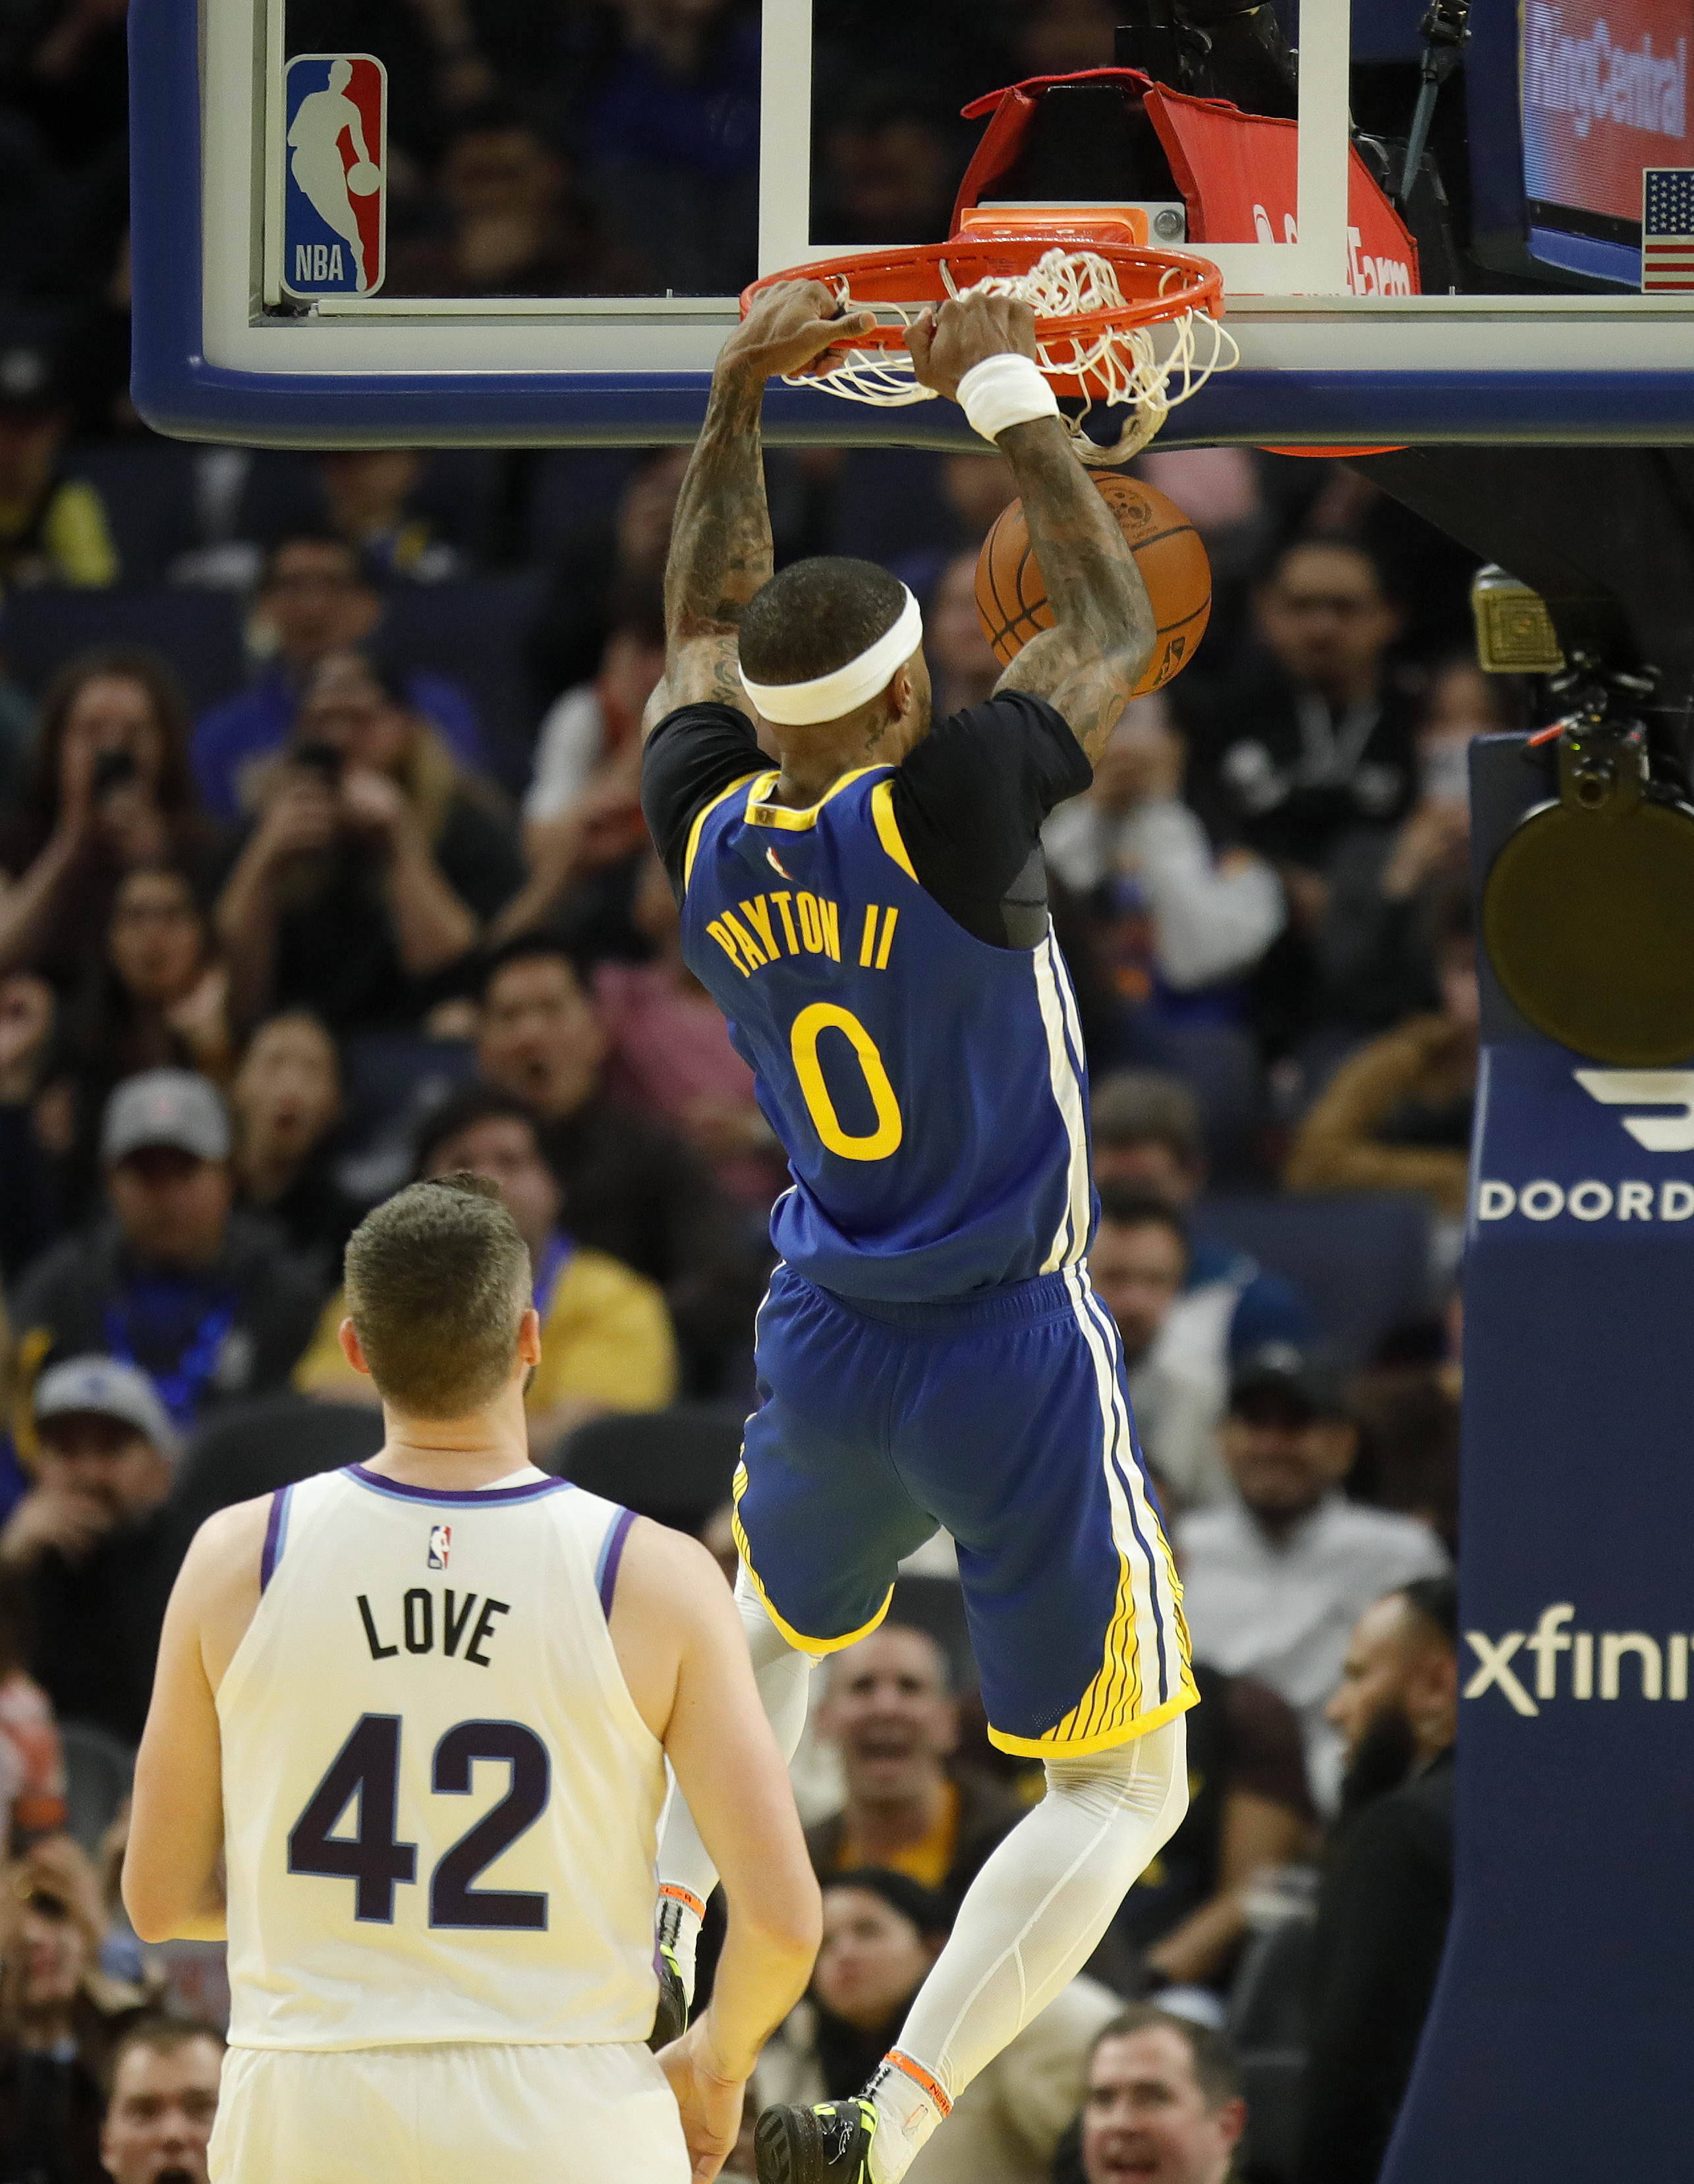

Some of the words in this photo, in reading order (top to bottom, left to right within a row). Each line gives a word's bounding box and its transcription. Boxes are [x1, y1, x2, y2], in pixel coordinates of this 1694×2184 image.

[296, 244, 344, 281] NBA
[706, 891, 841, 978] PAYTON
[859, 903, 899, 970] II
[791, 1001, 903, 1162] 0
[1479, 1179, 1694, 1221] DOORD
[356, 1588, 511, 1667] LOVE
[1463, 1601, 1694, 1717] xfini
[287, 1712, 551, 1931] 42
